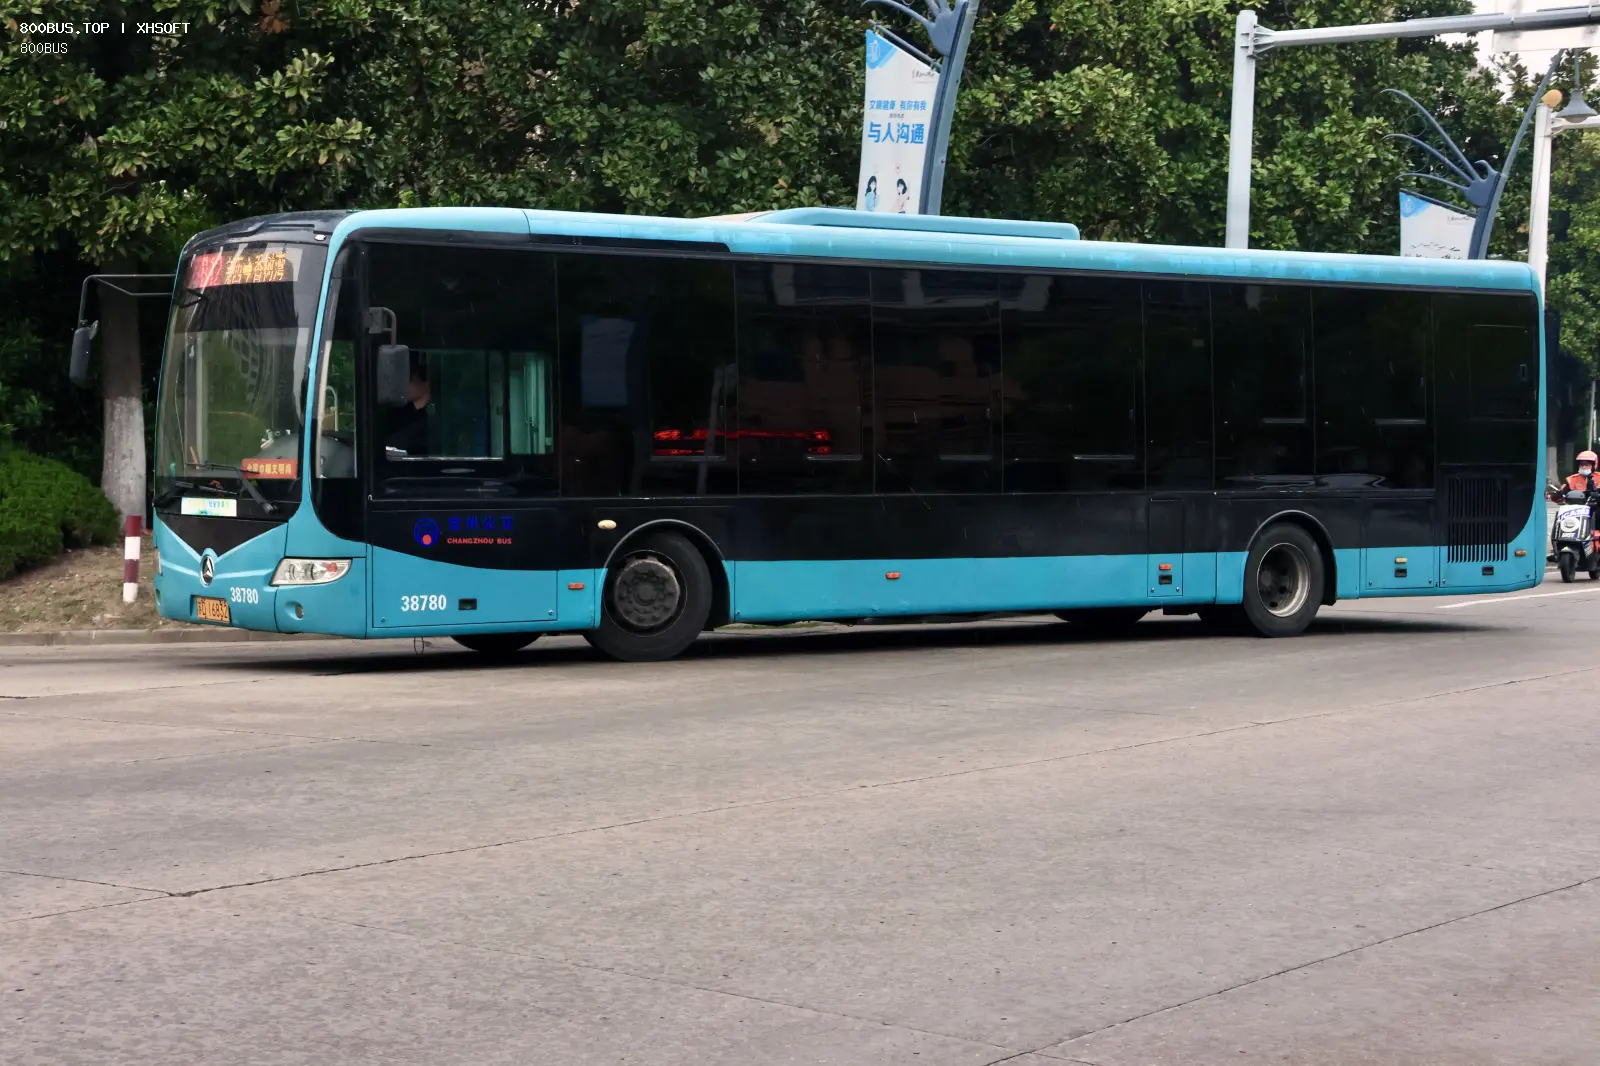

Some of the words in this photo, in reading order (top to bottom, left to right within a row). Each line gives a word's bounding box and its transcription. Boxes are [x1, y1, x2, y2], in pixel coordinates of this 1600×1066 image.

[867, 121, 925, 144] 与人沟通
[447, 515, 514, 531] 常州公交
[447, 537, 494, 545] CHANGZHOU
[496, 537, 512, 545] BUS
[229, 587, 259, 604] 38780
[400, 594, 447, 612] 38780
